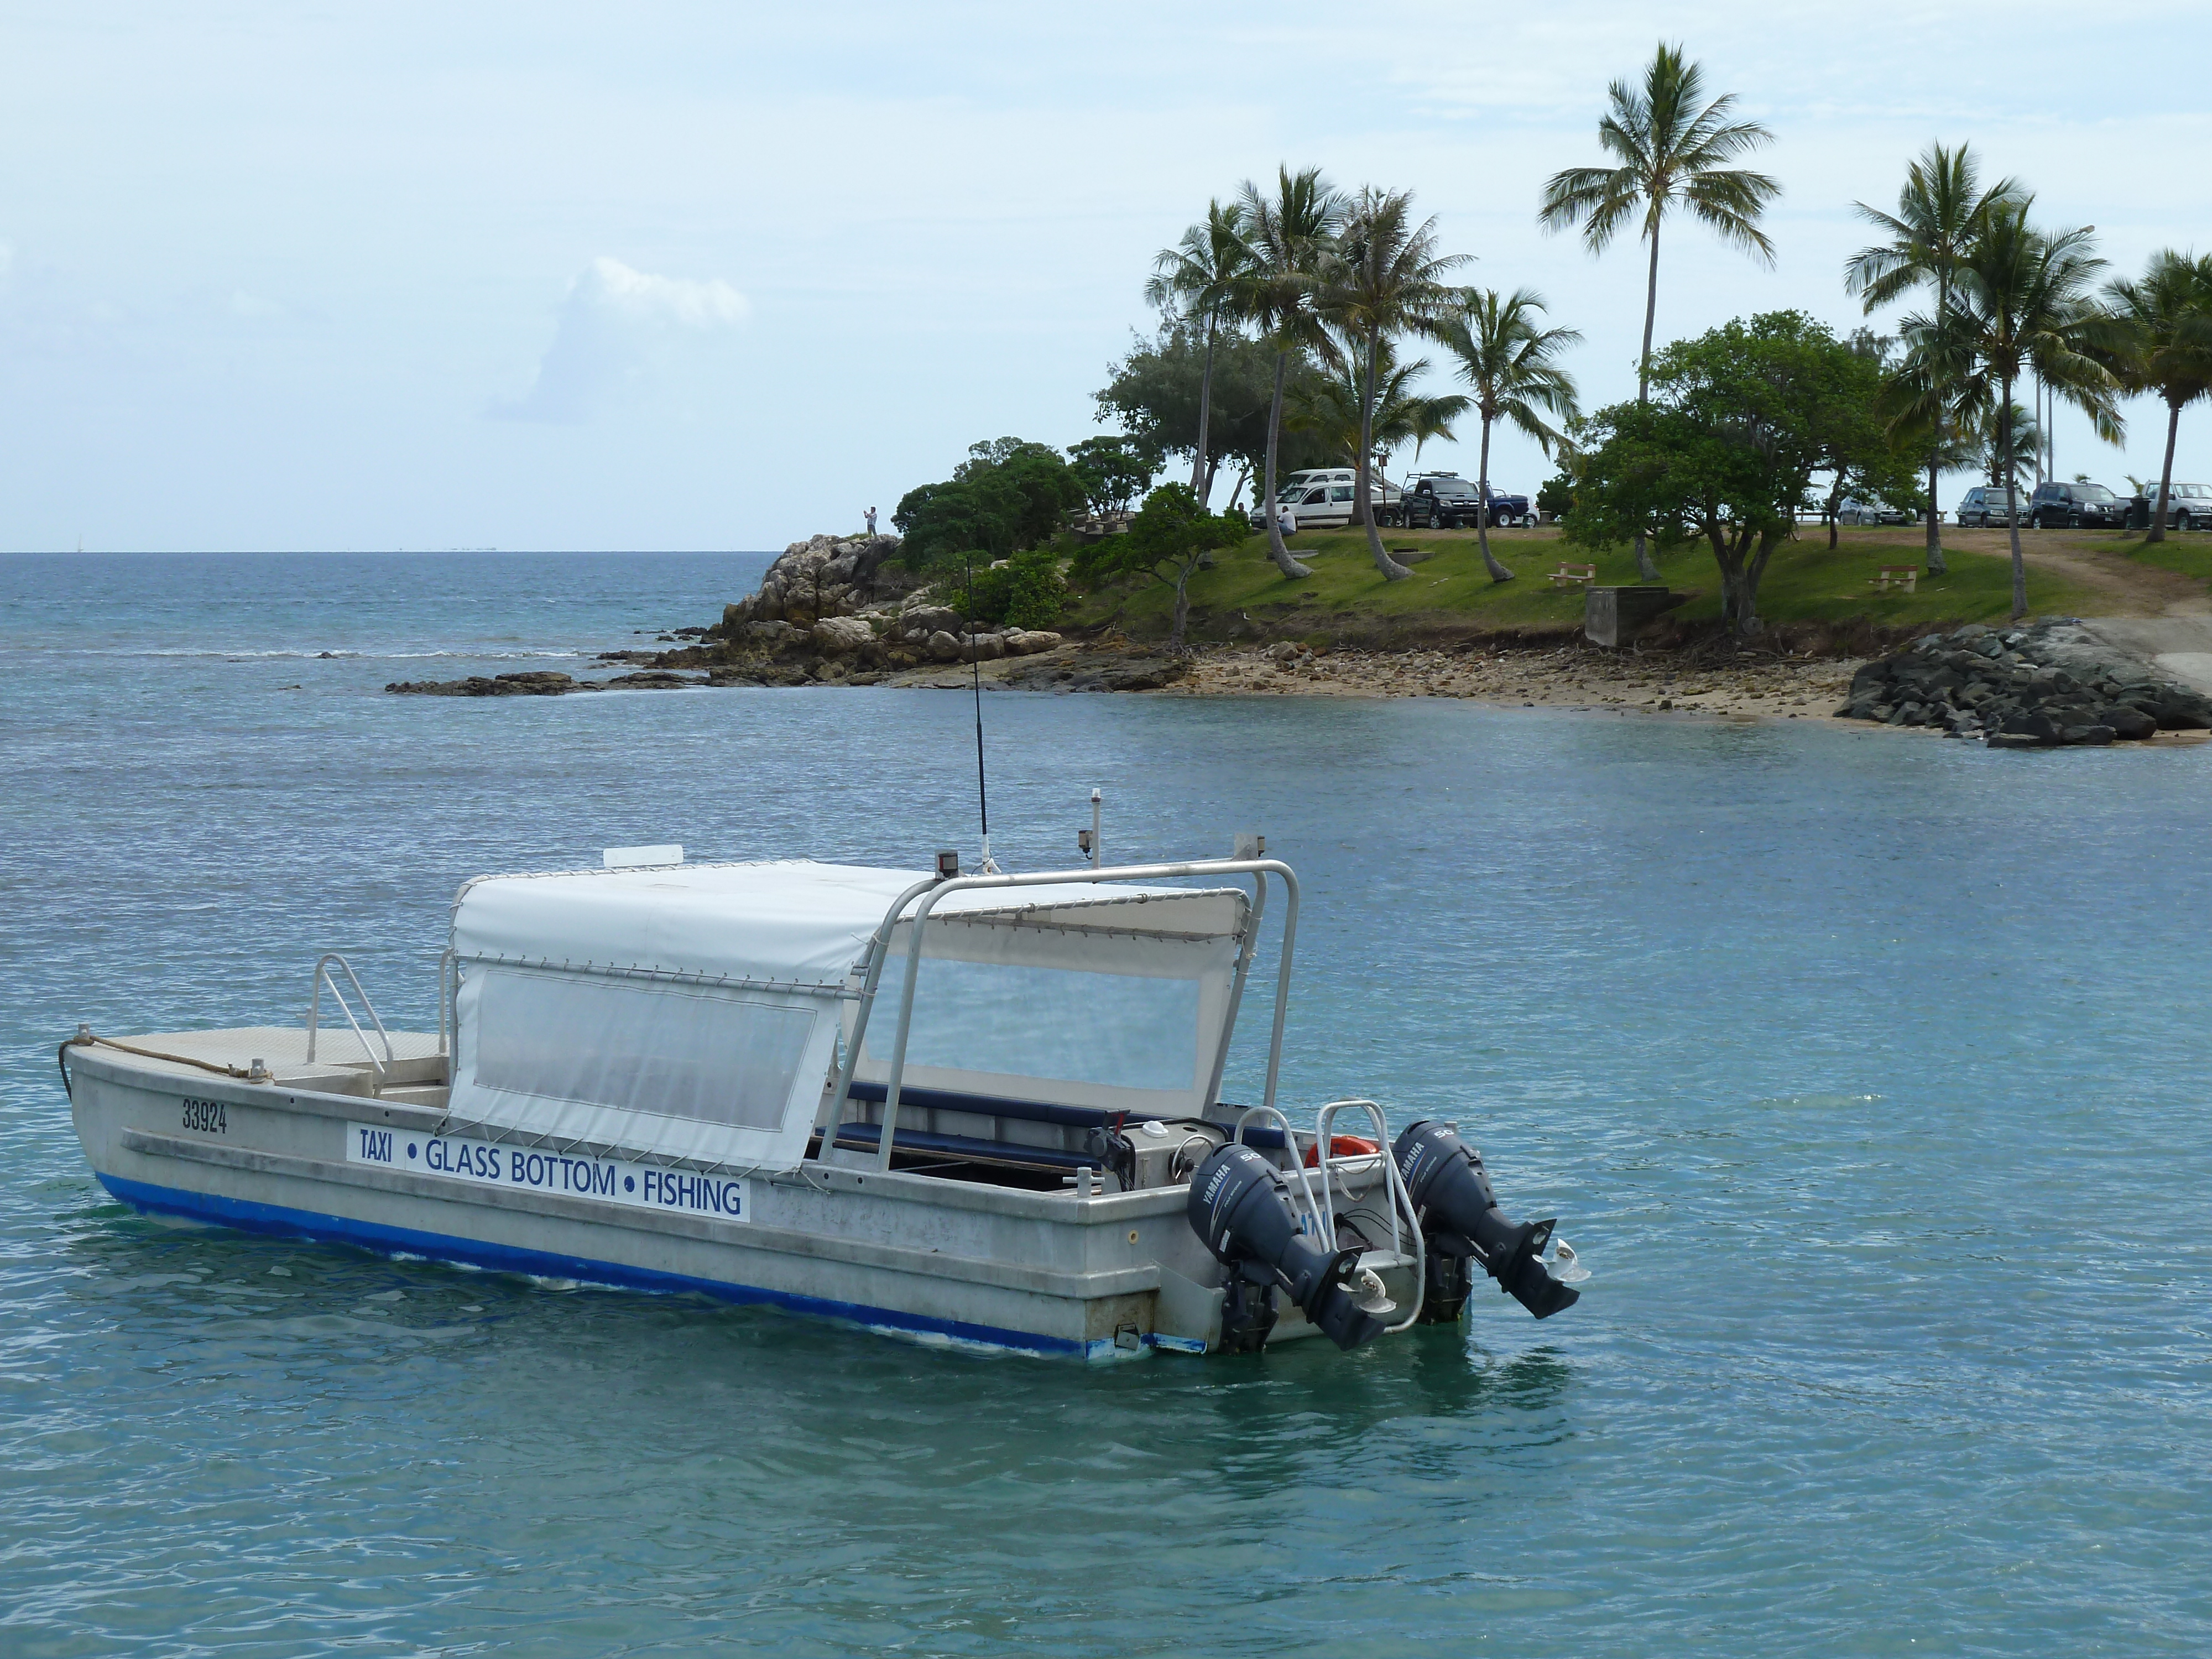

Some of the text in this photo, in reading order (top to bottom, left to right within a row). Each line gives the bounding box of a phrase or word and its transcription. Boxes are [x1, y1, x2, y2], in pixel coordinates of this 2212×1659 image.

[183, 1098, 227, 1134] 33924
[1434, 1130, 1454, 1138] 50
[361, 1129, 740, 1215] TAXI GLASS BOTTOM FISHING
[1240, 1153, 1262, 1162] 50
[1203, 1164, 1231, 1204] YAMAHA
